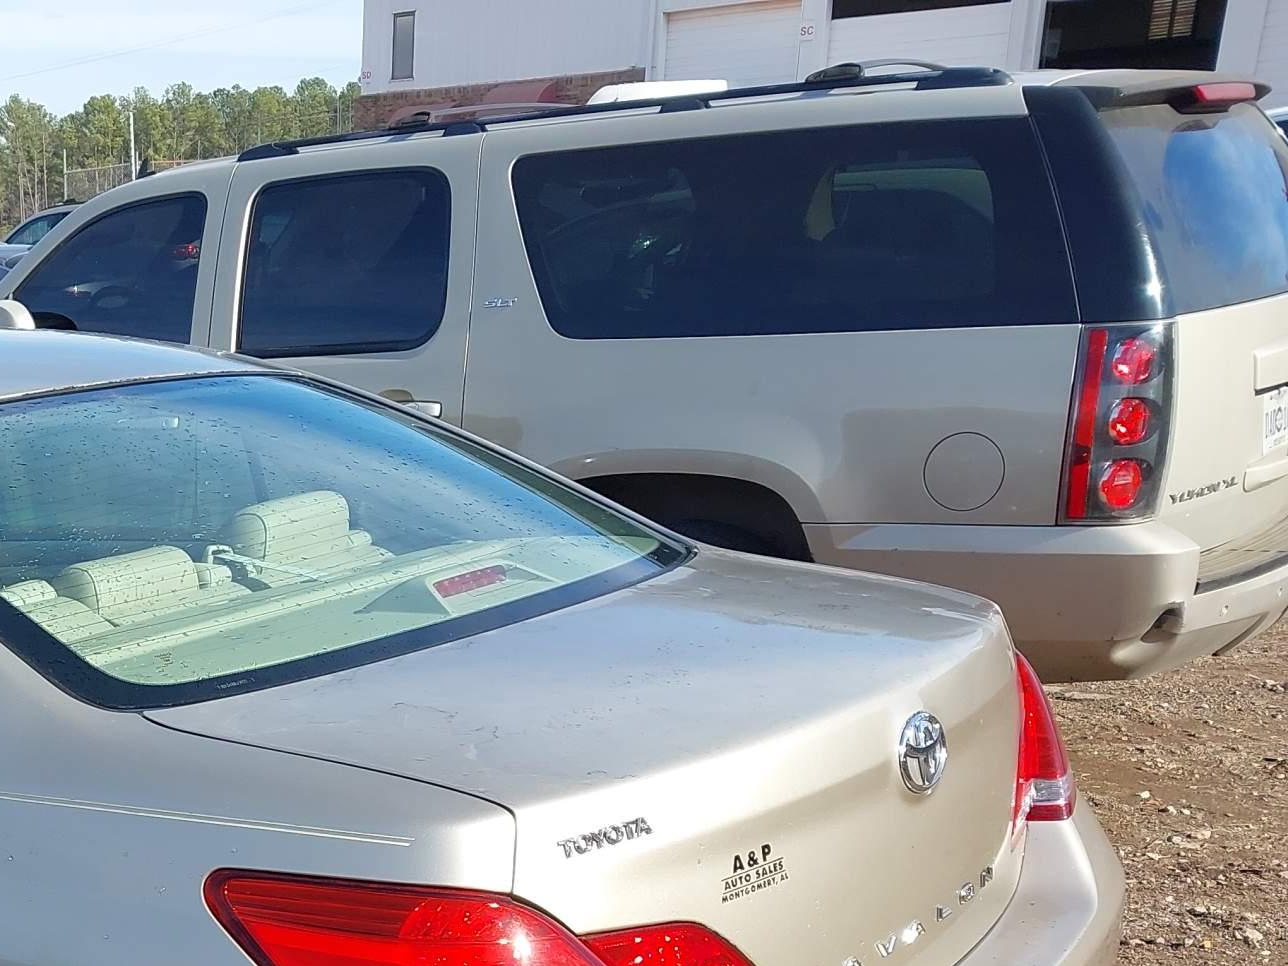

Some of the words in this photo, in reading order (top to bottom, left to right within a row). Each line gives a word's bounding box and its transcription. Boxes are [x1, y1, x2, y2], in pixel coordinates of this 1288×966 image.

[800, 25, 814, 36] SC
[557, 817, 652, 859] TOYOTA
[732, 854, 745, 873] A
[747, 851, 759, 867] &
[761, 844, 772, 862] P
[724, 873, 751, 891] AUTO
[755, 860, 784, 879] SALES
[721, 877, 779, 904] MONTGOMERY,
